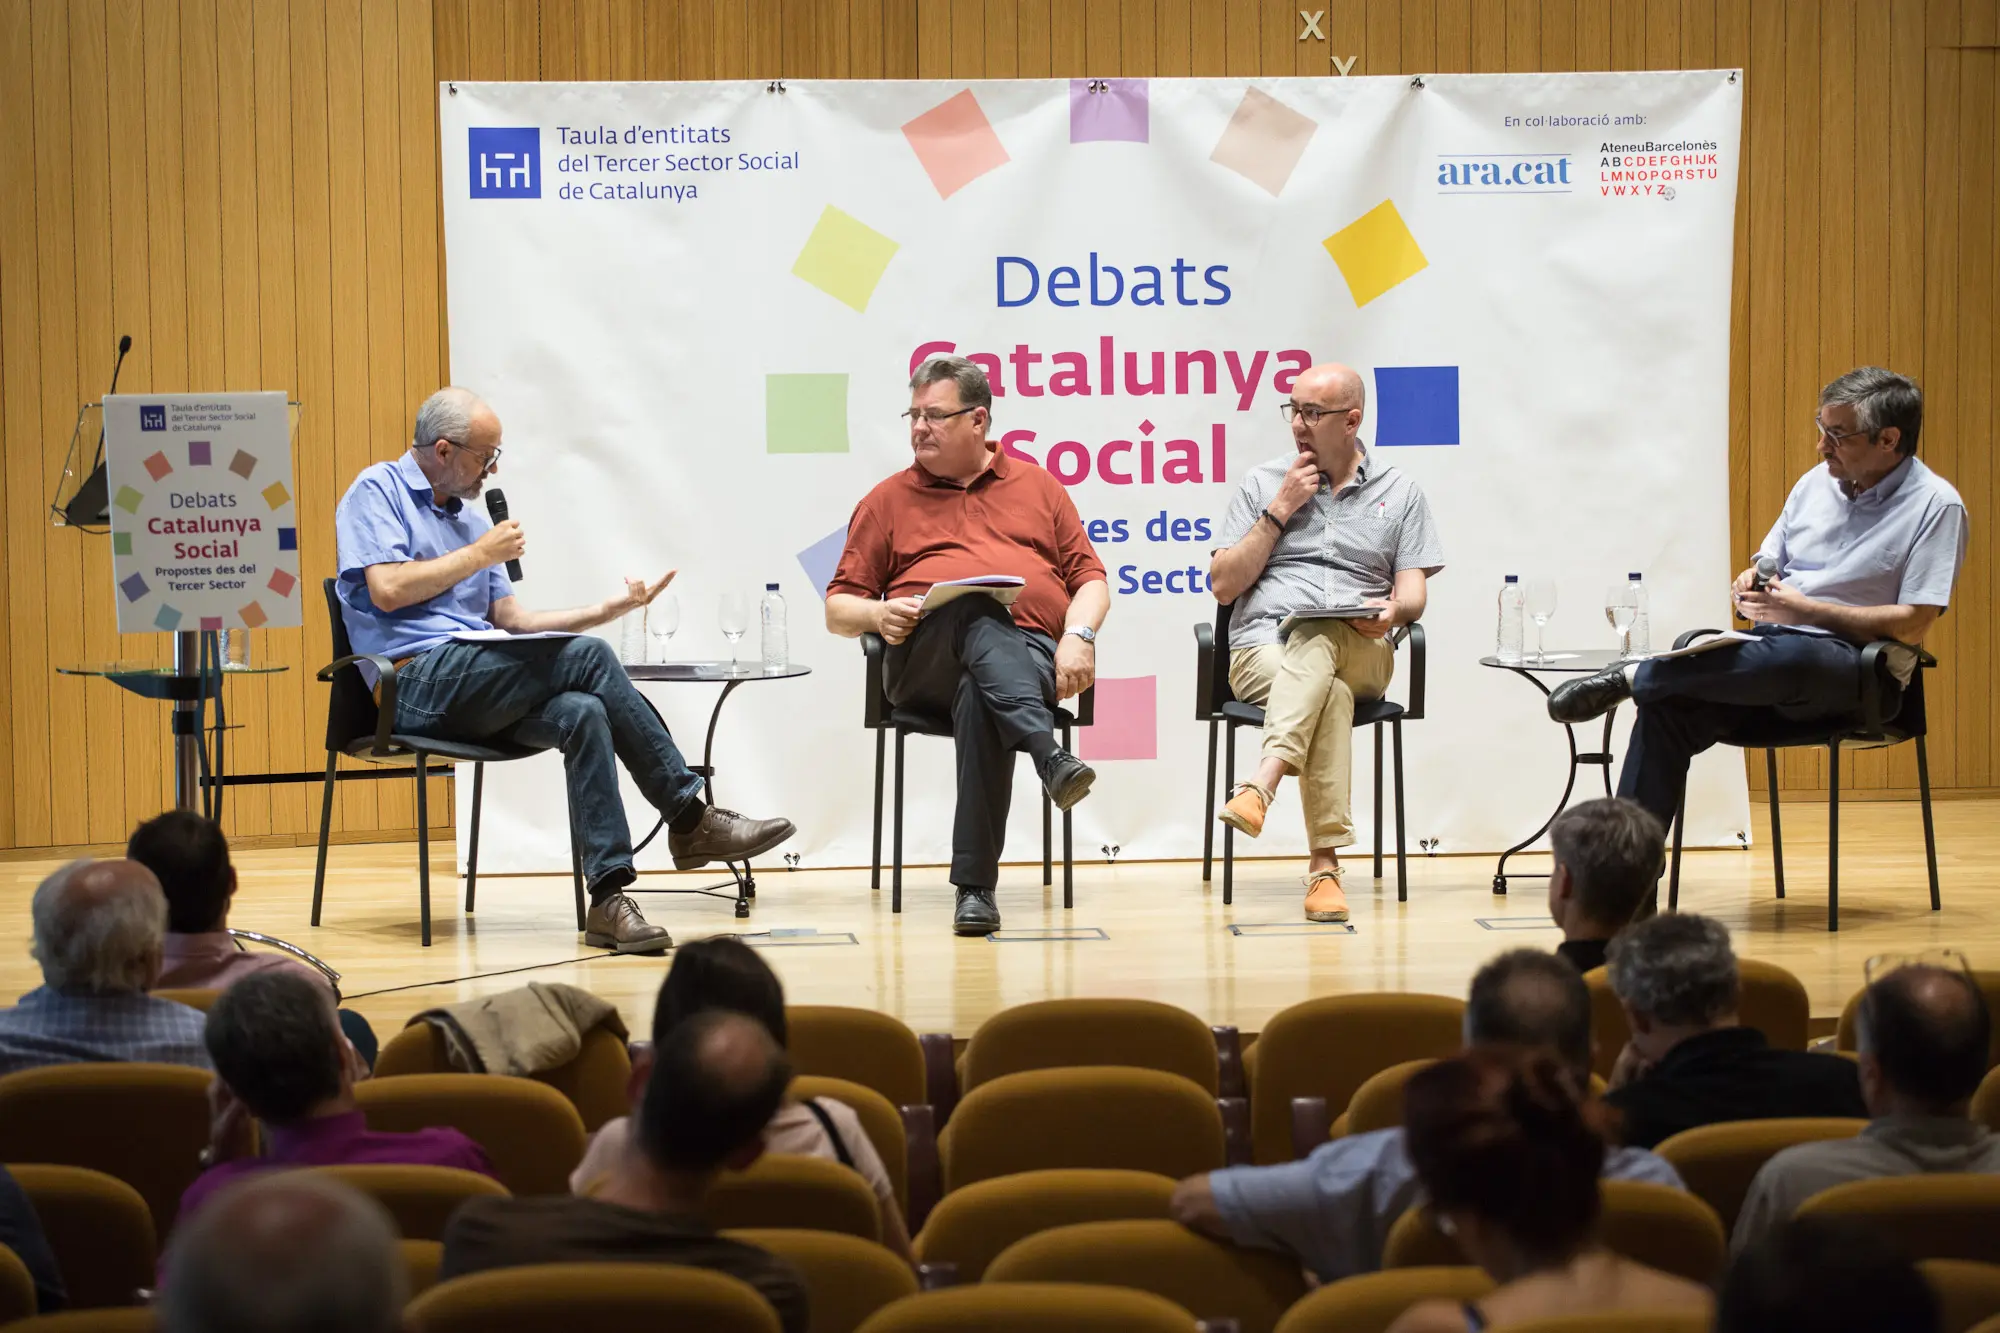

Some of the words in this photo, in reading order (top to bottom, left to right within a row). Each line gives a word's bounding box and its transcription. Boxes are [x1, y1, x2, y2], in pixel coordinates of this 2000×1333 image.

[1299, 10, 1325, 40] X
[1504, 116, 1521, 127] En
[1525, 114, 1610, 127] col·laboració
[1614, 113, 1648, 126] amb:
[556, 126, 618, 145] Taula
[623, 124, 731, 145] d'entitats
[557, 154, 589, 173] del
[593, 154, 661, 173] Tercer
[665, 154, 734, 172] Sector
[738, 151, 799, 170] Social
[1437, 157, 1572, 187] ara.cat
[558, 182, 584, 200] de
[589, 181, 698, 204] Catalunya
[996, 252, 1232, 308] Debats
[170, 403, 193, 412] Taula
[171, 414, 183, 422] del
[184, 414, 207, 422] Tercer
[208, 413, 233, 421] Sector
[234, 412, 256, 421] Social
[182, 424, 222, 432] Catalunya
[170, 492, 238, 509] Debats
[147, 516, 262, 536] Catalunya
[1145, 510, 1212, 542] des
[174, 540, 239, 560] Social
[156, 566, 213, 578] Propostes
[216, 564, 236, 575] des
[238, 564, 256, 575] del
[1118, 565, 1213, 595] Sect
[168, 581, 206, 592] Tercer
[209, 579, 246, 591] Sector
